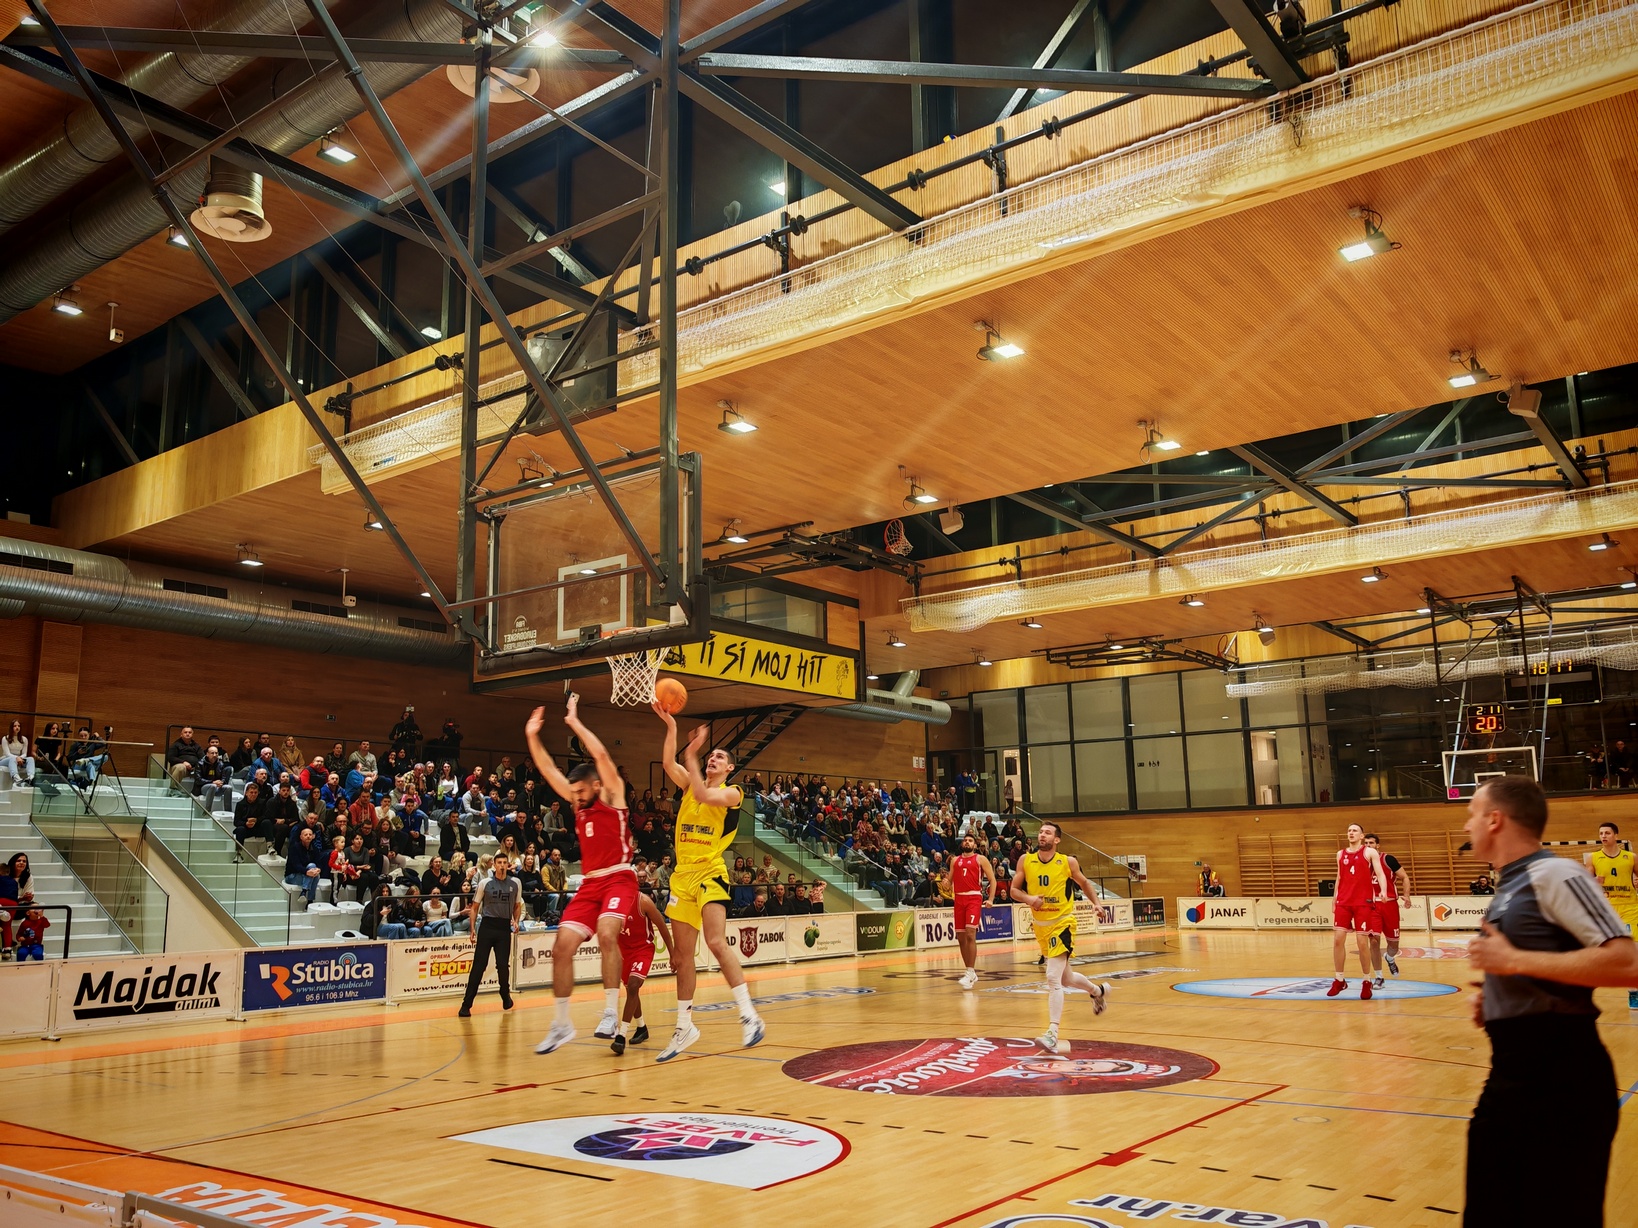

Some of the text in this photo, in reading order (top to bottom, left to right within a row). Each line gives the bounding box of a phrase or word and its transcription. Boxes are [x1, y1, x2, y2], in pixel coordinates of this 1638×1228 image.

[750, 649, 792, 681] MOJ
[1475, 716, 1497, 731] 20
[962, 867, 968, 877] 7
[1350, 865, 1356, 875] 4
[1038, 874, 1050, 887] 10
[607, 896, 621, 910] 8
[969, 914, 975, 924] 7
[1210, 907, 1247, 919] JANAF
[1264, 915, 1329, 926] regeneracija
[1360, 921, 1367, 931] 4
[759, 931, 785, 944] ZABOK
[291, 959, 375, 985] Stubica
[630, 961, 643, 972] 24
[651, 963, 668, 971] ZVUK
[73, 963, 221, 1012] Majdak
[295, 980, 374, 994] www.radio-stubica.hr
[305, 993, 321, 1002] 95.6
[325, 990, 344, 1000] 106.9
[344, 989, 359, 999] Mhz
[612, 1116, 820, 1148] FAVBET
